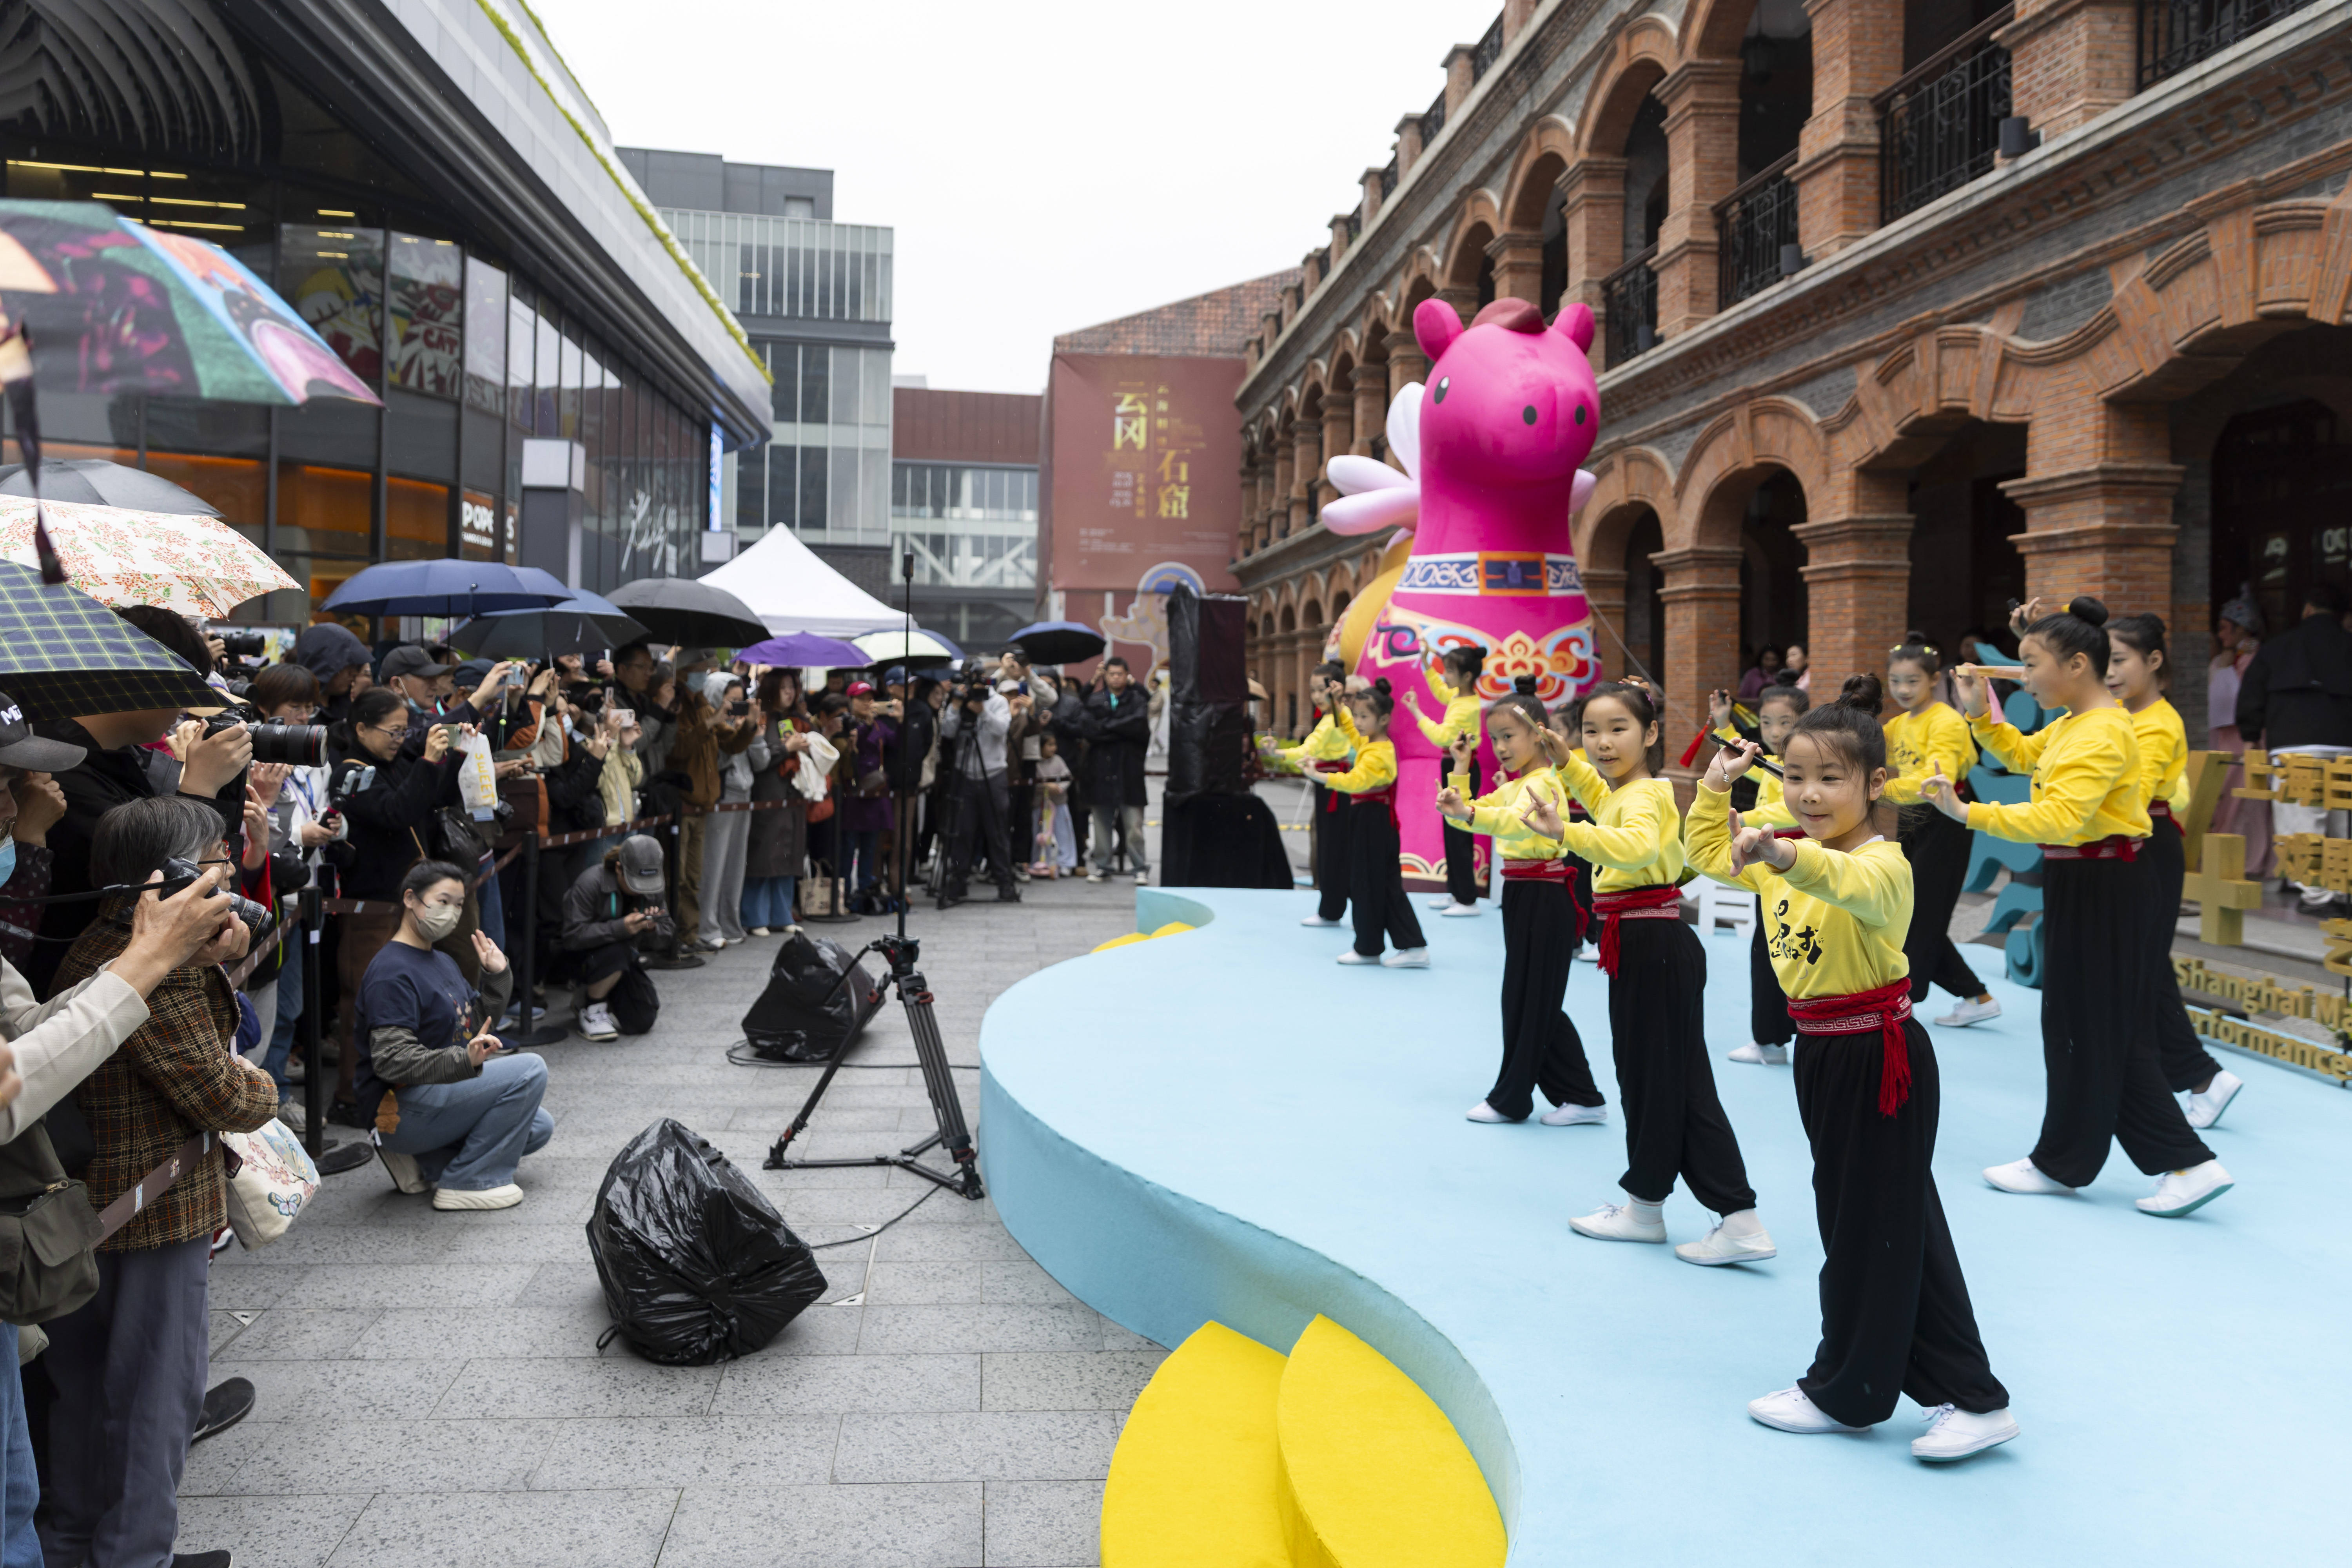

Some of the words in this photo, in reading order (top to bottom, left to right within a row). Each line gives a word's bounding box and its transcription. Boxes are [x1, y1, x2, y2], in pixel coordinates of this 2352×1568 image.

[423, 328, 458, 354] CAT
[1112, 381, 1149, 450] 云冈
[1156, 448, 1191, 519] 石窟
[475, 753, 495, 805] SWEET
[2174, 957, 2314, 1019] Shanghai
[2187, 1008, 2352, 1082] rformance
